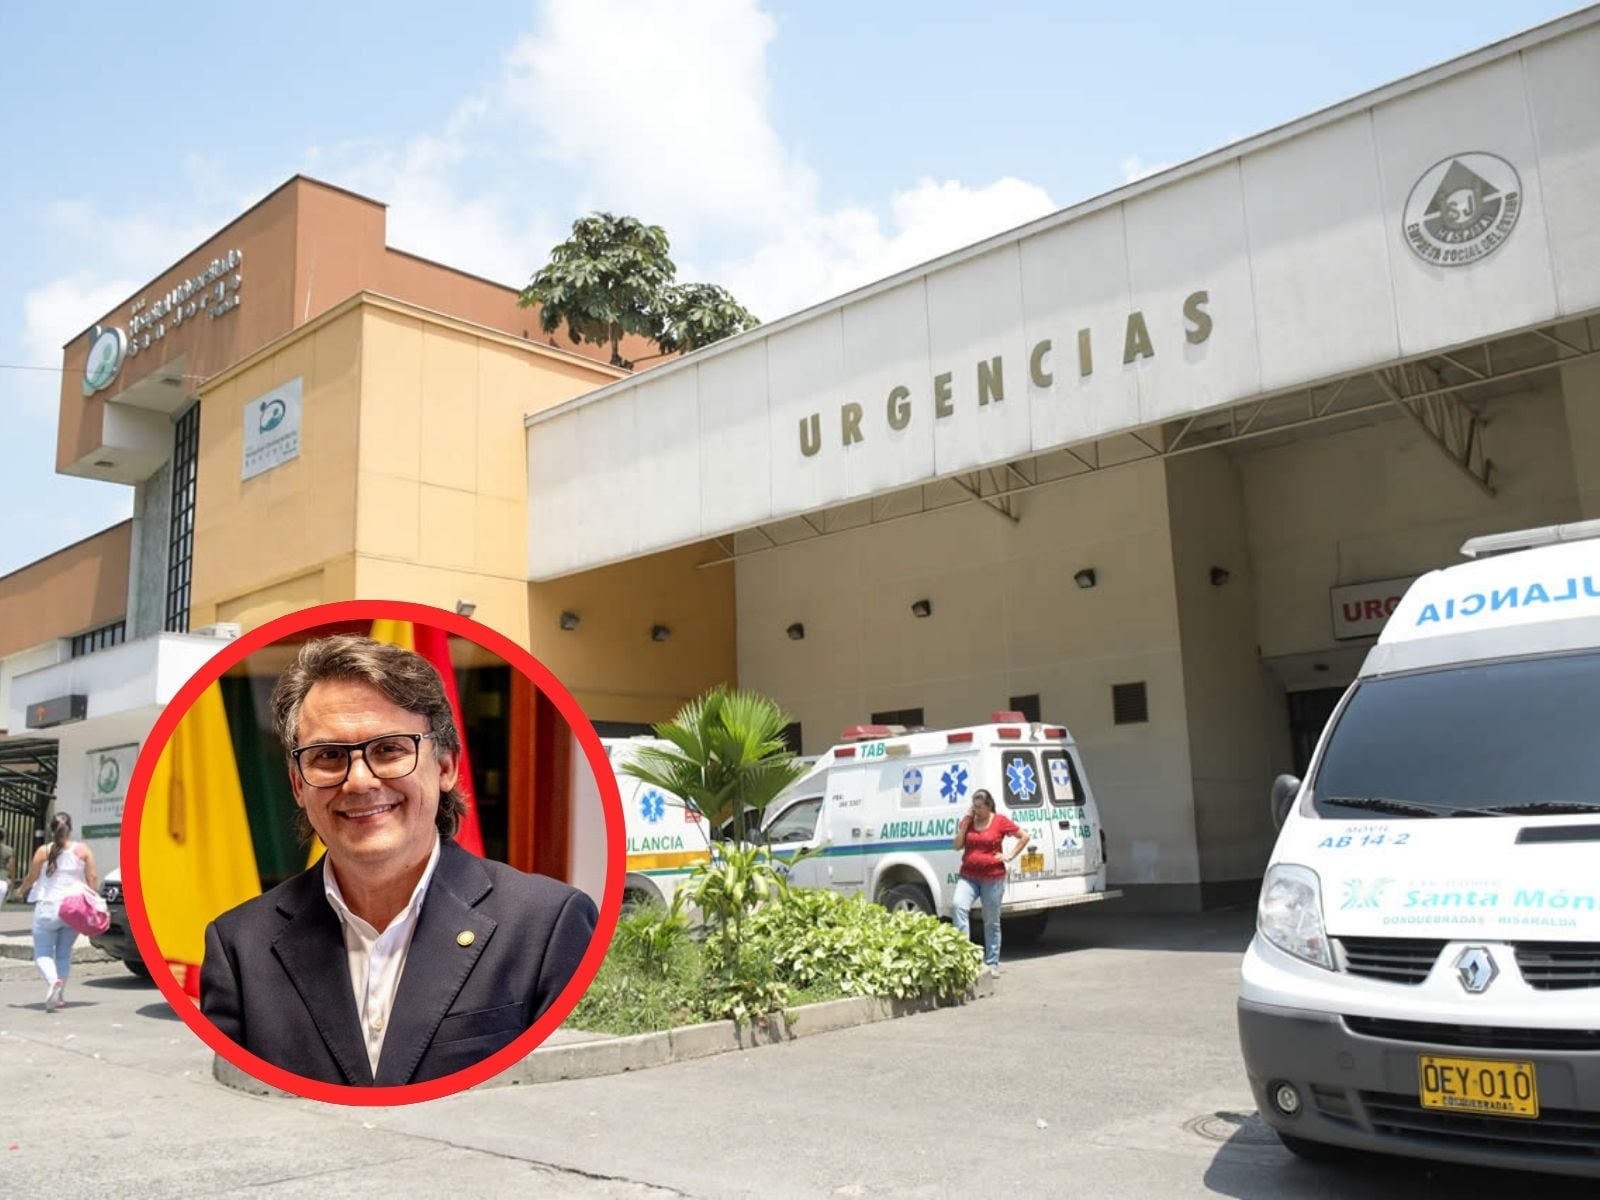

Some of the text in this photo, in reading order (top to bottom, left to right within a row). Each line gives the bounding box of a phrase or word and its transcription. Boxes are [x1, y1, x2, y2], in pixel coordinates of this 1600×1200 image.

[1442, 243, 1482, 262] SOCIAL
[1481, 231, 1503, 251] DEL
[798, 290, 1213, 458] URGENCIAS
[860, 742, 885, 758] TAB
[1012, 807, 1086, 822] AMBULANCIA
[880, 817, 960, 839] AMBULANCI
[1072, 825, 1091, 838] TAB
[1318, 836, 1352, 848] AB
[1403, 890, 1499, 908] Santa
[1424, 1064, 1530, 1101] OEY 010
